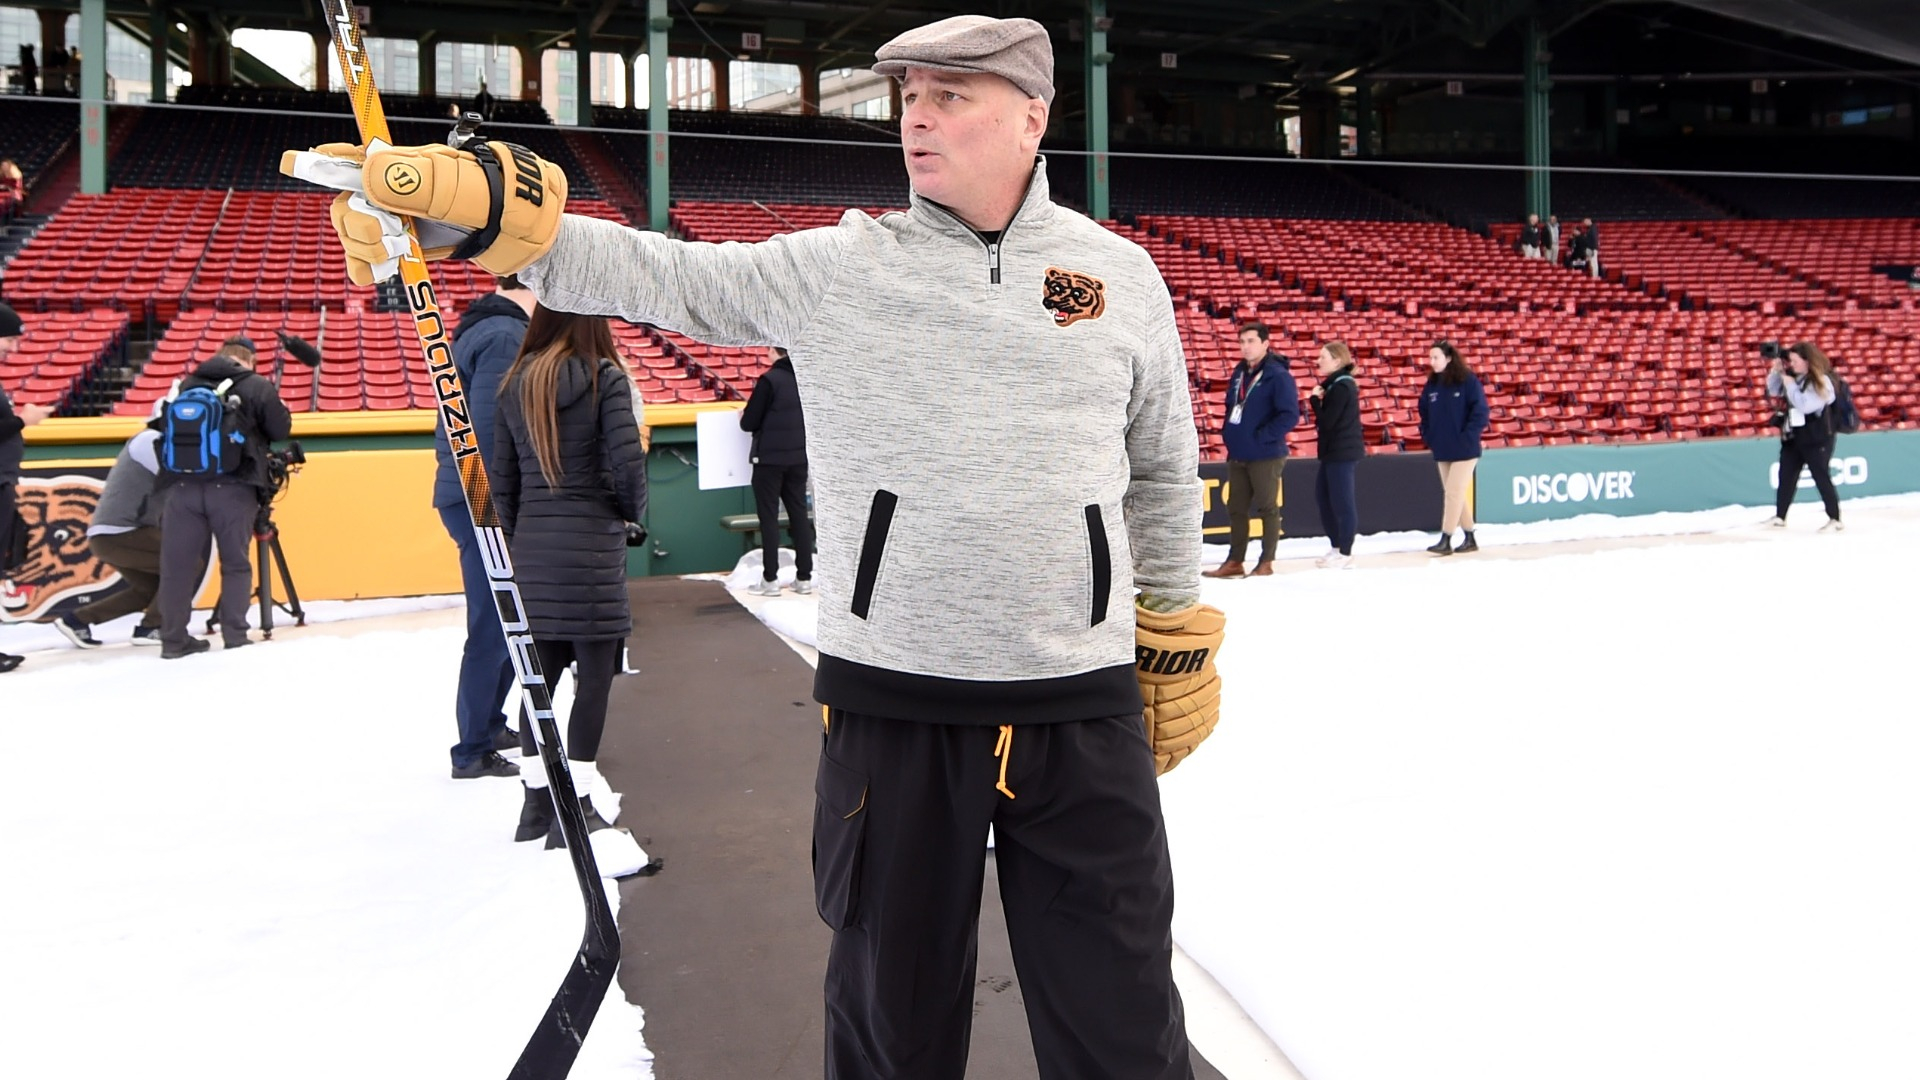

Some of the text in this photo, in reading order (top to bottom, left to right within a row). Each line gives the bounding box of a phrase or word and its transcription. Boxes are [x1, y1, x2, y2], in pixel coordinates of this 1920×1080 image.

[408, 280, 478, 458] HZRDUS
[1513, 470, 1635, 505] DISCOVER
[475, 526, 555, 746] TRUE
